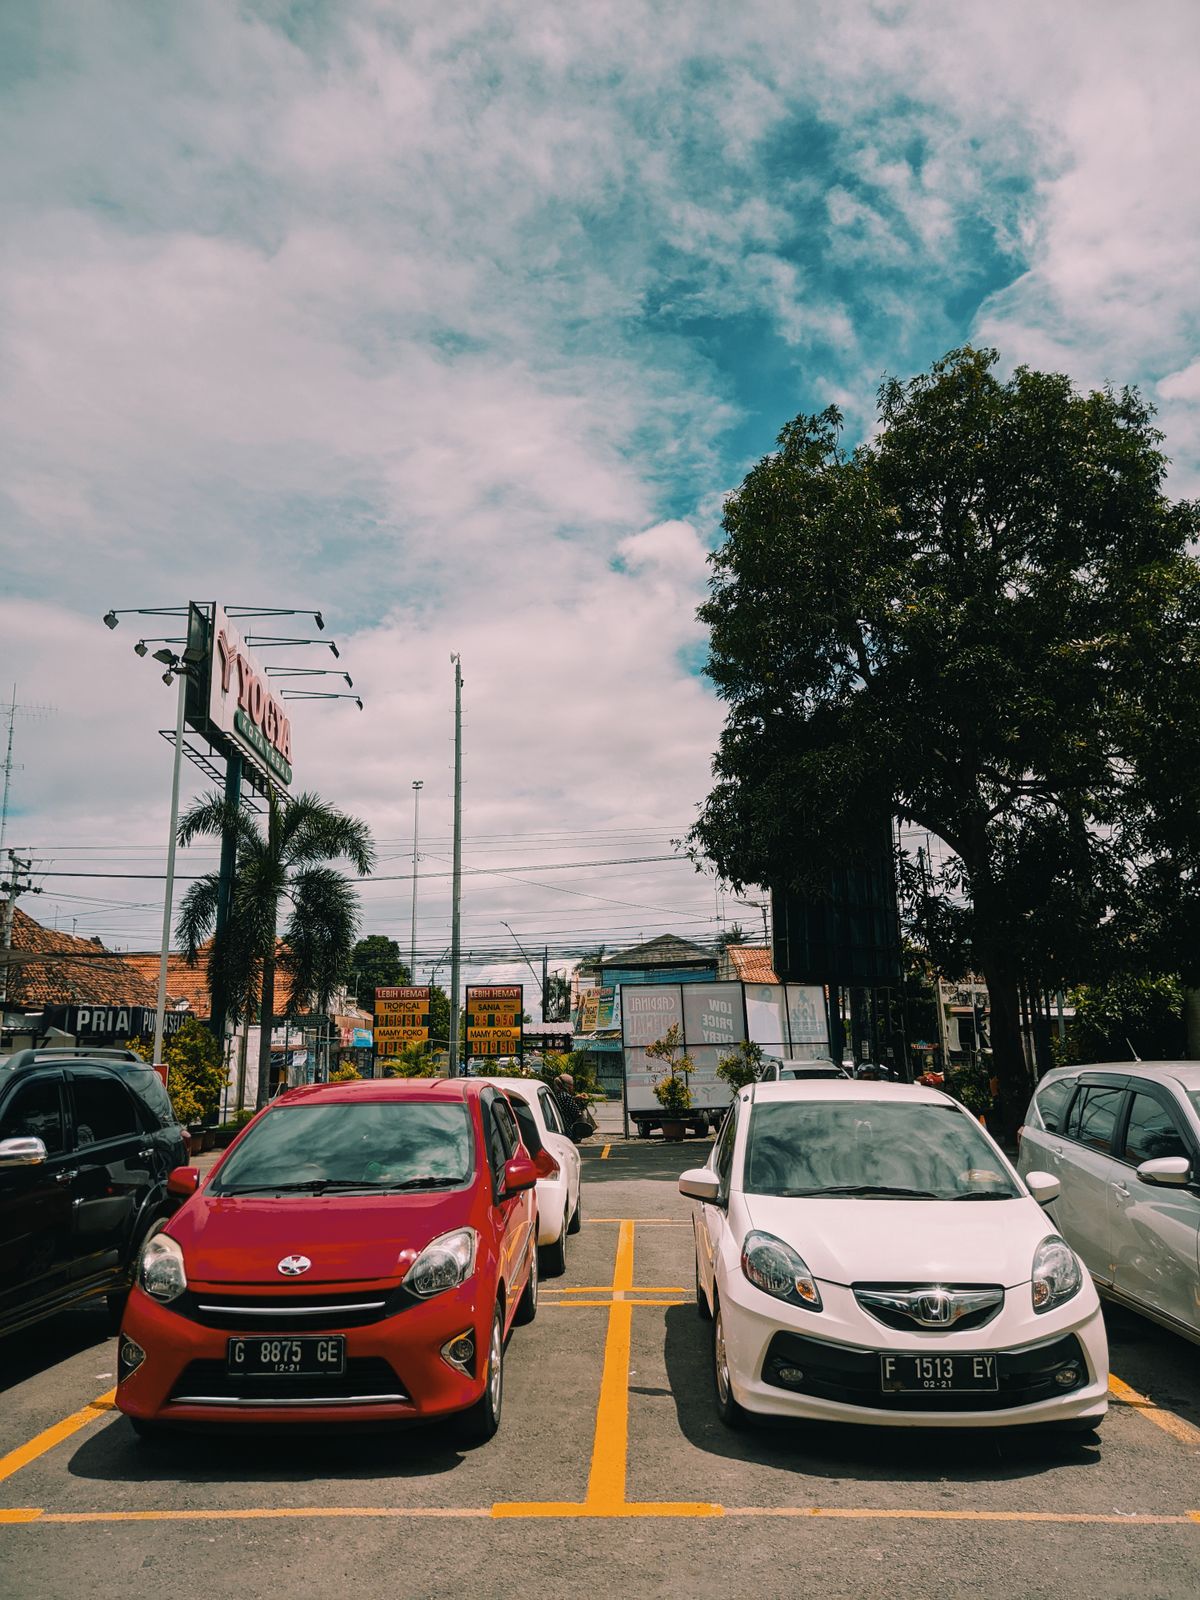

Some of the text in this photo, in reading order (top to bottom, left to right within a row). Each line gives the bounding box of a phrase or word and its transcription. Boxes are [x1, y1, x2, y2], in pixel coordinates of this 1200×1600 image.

[236, 652, 293, 766] YOGYA
[241, 720, 290, 780] KOTA TEGAL
[377, 989, 426, 998] LEBIH HEMAT
[470, 989, 518, 998] LEBIH HEMAT
[478, 1003, 501, 1011] SANIA
[76, 1010, 129, 1032] PRIA
[378, 1029, 401, 1037] MAMY
[402, 1029, 423, 1037] POKO
[470, 1030, 491, 1038] MAMY
[492, 1029, 512, 1038] POKO
[235, 1341, 338, 1362] G 8875 GE
[885, 1357, 993, 1379] F 1513 EY
